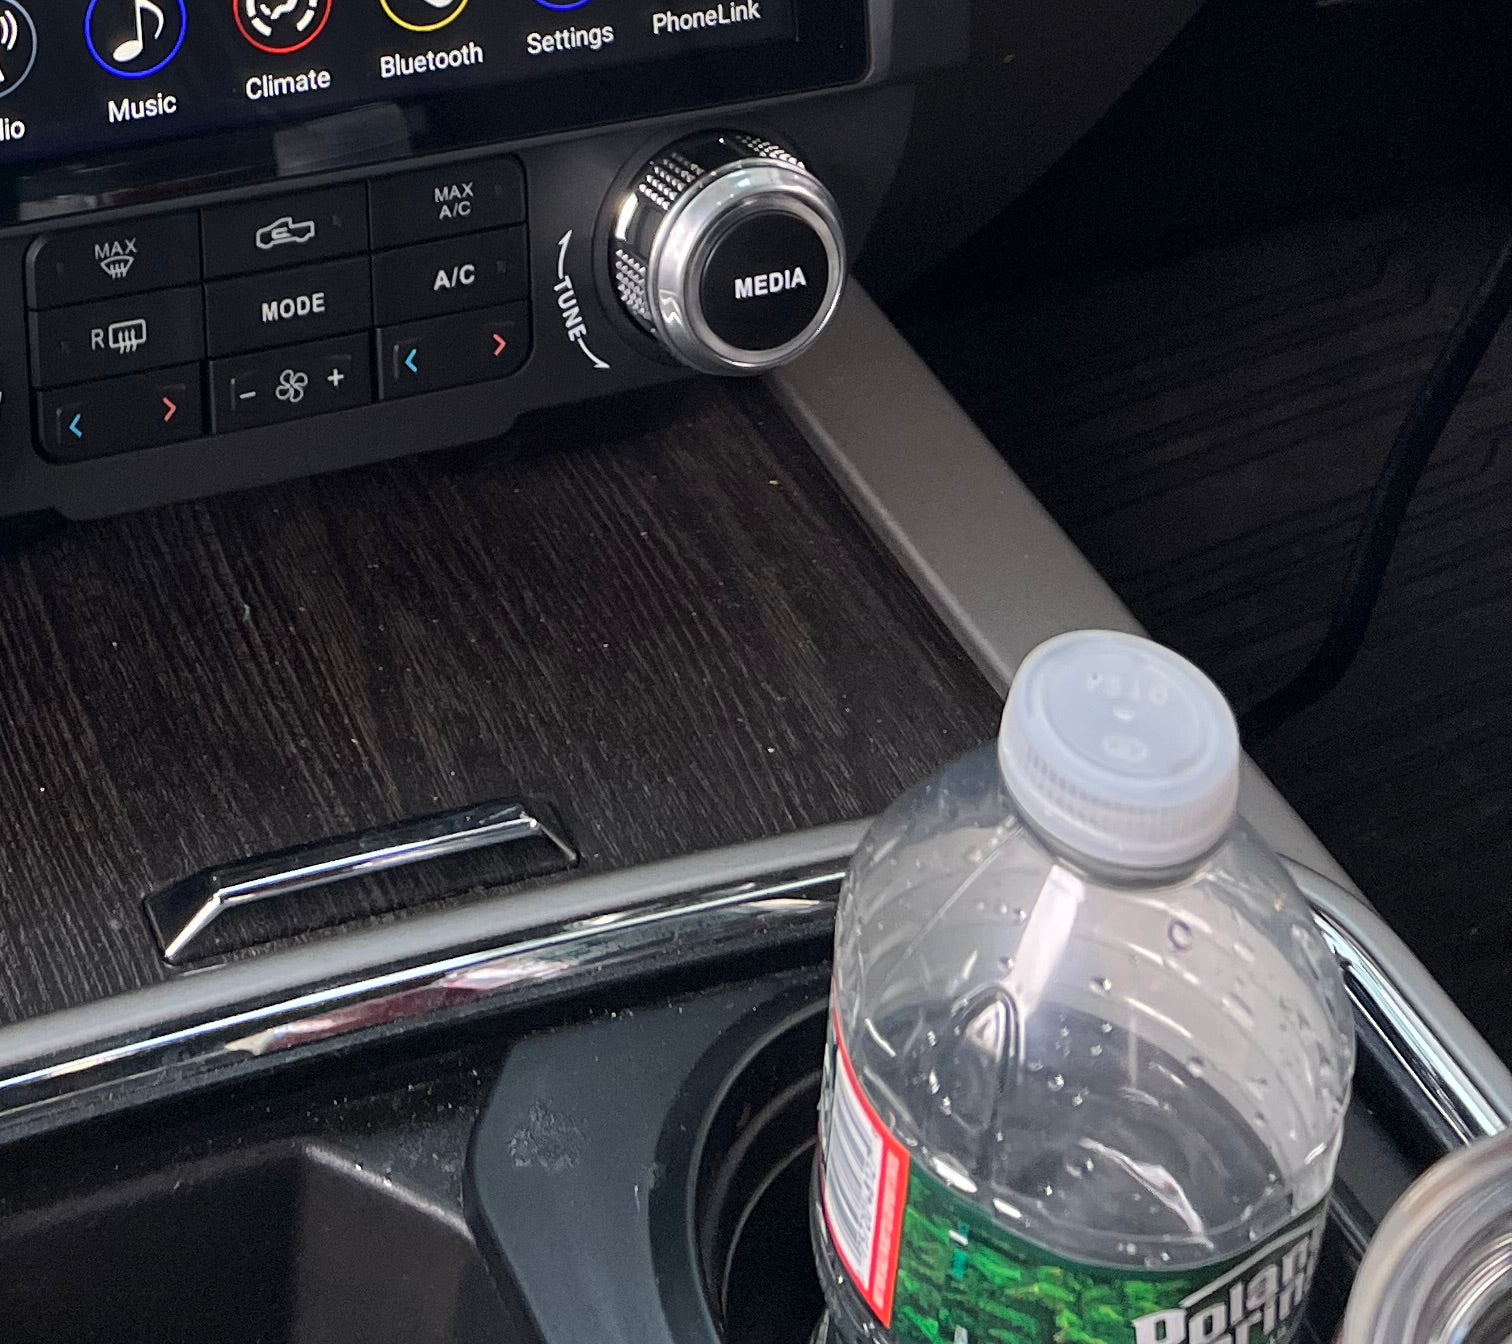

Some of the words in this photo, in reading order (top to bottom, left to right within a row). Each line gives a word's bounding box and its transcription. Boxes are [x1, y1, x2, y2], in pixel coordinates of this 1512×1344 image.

[525, 21, 616, 56] Settings
[379, 41, 485, 79] Bluetooth
[244, 67, 332, 102] Climate
[107, 91, 178, 124] Music
[432, 181, 475, 204] MAX
[438, 199, 473, 222] A/C
[93, 237, 139, 261] MAX
[432, 263, 477, 292] A/C
[733, 266, 808, 301] MEDIA
[260, 291, 327, 323] MODE
[552, 274, 587, 342] TUNE
[90, 328, 105, 350] R
[1132, 1217, 1326, 1344] Polan
